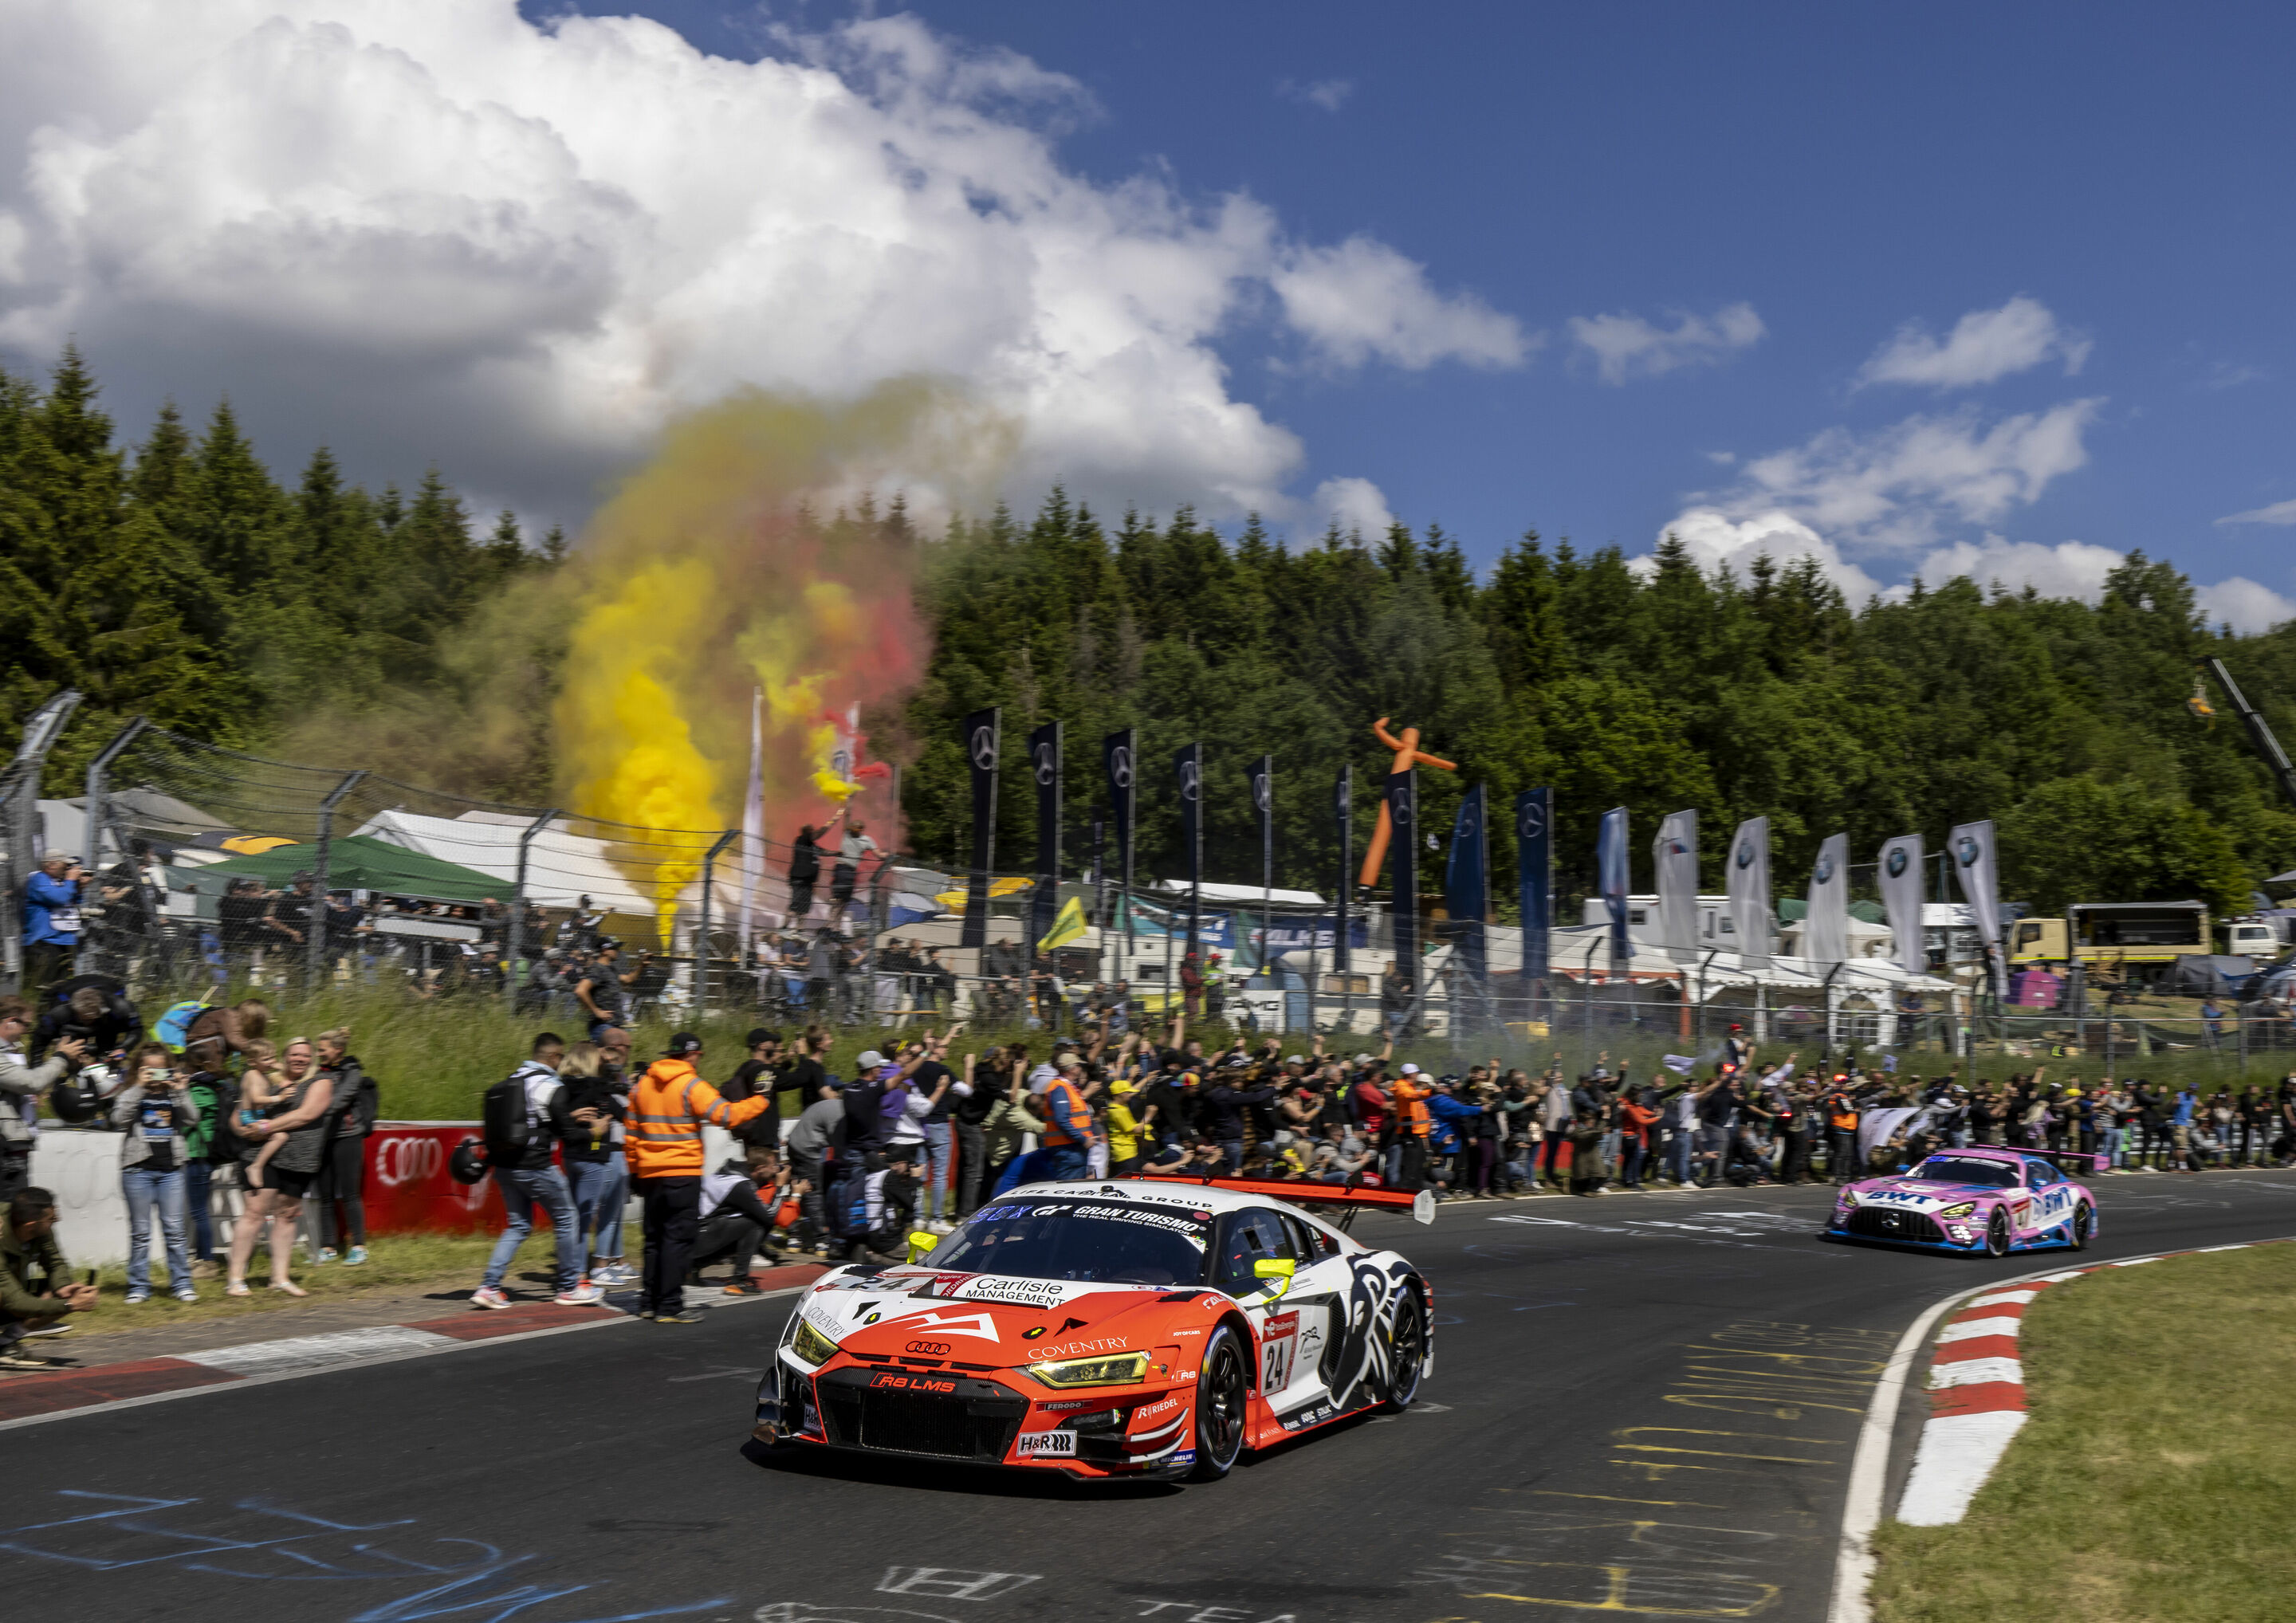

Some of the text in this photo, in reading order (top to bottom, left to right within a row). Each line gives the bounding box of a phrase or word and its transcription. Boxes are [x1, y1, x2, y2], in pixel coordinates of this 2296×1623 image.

[1142, 1195, 1213, 1208] GROUP
[1866, 1191, 1933, 1205] BWT
[1074, 1205, 1200, 1232] GRAN TURISMO
[1111, 1216, 1143, 1228] DRIVING
[1143, 1220, 1191, 1236] SIMULATOR
[977, 1278, 1064, 1295] Carlisle
[965, 1290, 1065, 1307] MANAGEMENT
[808, 1307, 847, 1338] COVENTRY
[1028, 1336, 1127, 1360] COVENTRY
[1265, 1342, 1284, 1390] 24
[1181, 1370, 1196, 1380] R8
[879, 1377, 956, 1393] R8 LMS
[1048, 1401, 1082, 1410] FERODO
[1152, 1397, 1178, 1414] RIEDEL
[1020, 1436, 1051, 1452] H&R
